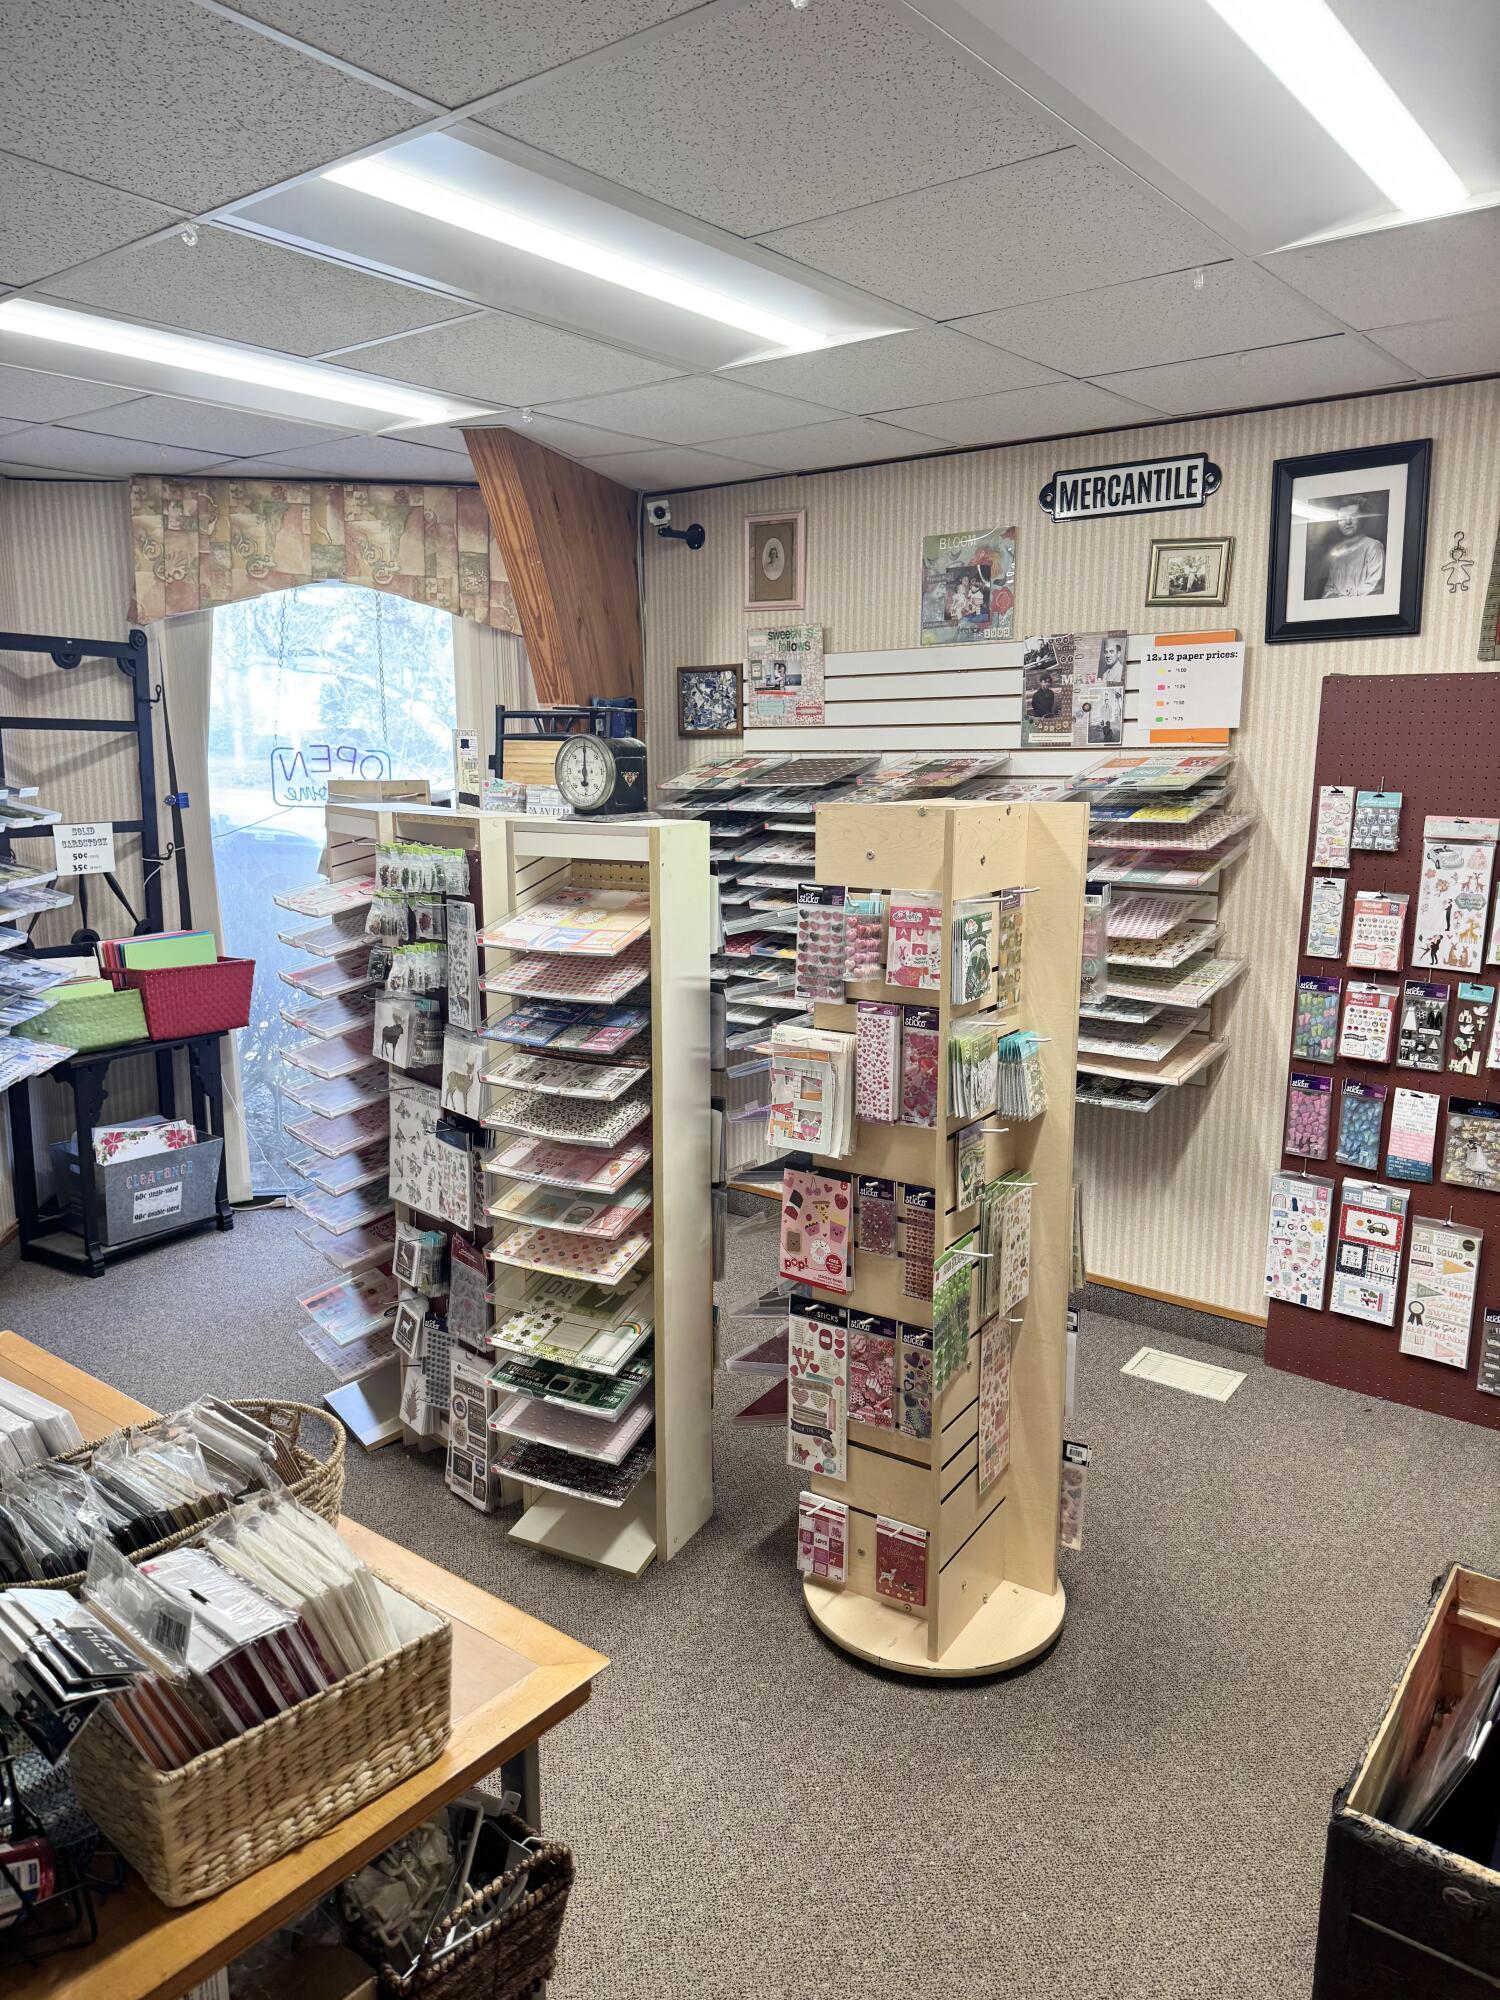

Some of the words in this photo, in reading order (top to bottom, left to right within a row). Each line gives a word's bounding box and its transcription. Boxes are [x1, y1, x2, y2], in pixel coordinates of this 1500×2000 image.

[1059, 464, 1199, 513] MERCANTILE
[938, 534, 977, 550] BLOOM
[1146, 653, 1175, 662] 12x12
[1176, 652, 1205, 661] paper
[1206, 650, 1238, 660] prices:
[71, 827, 95, 836] SOLID
[1412, 1243, 1432, 1254] GIRL
[1436, 1248, 1464, 1260] SQUAD
[784, 1257, 808, 1271] pop!
[80, 1627, 129, 1669] BAZZILL
